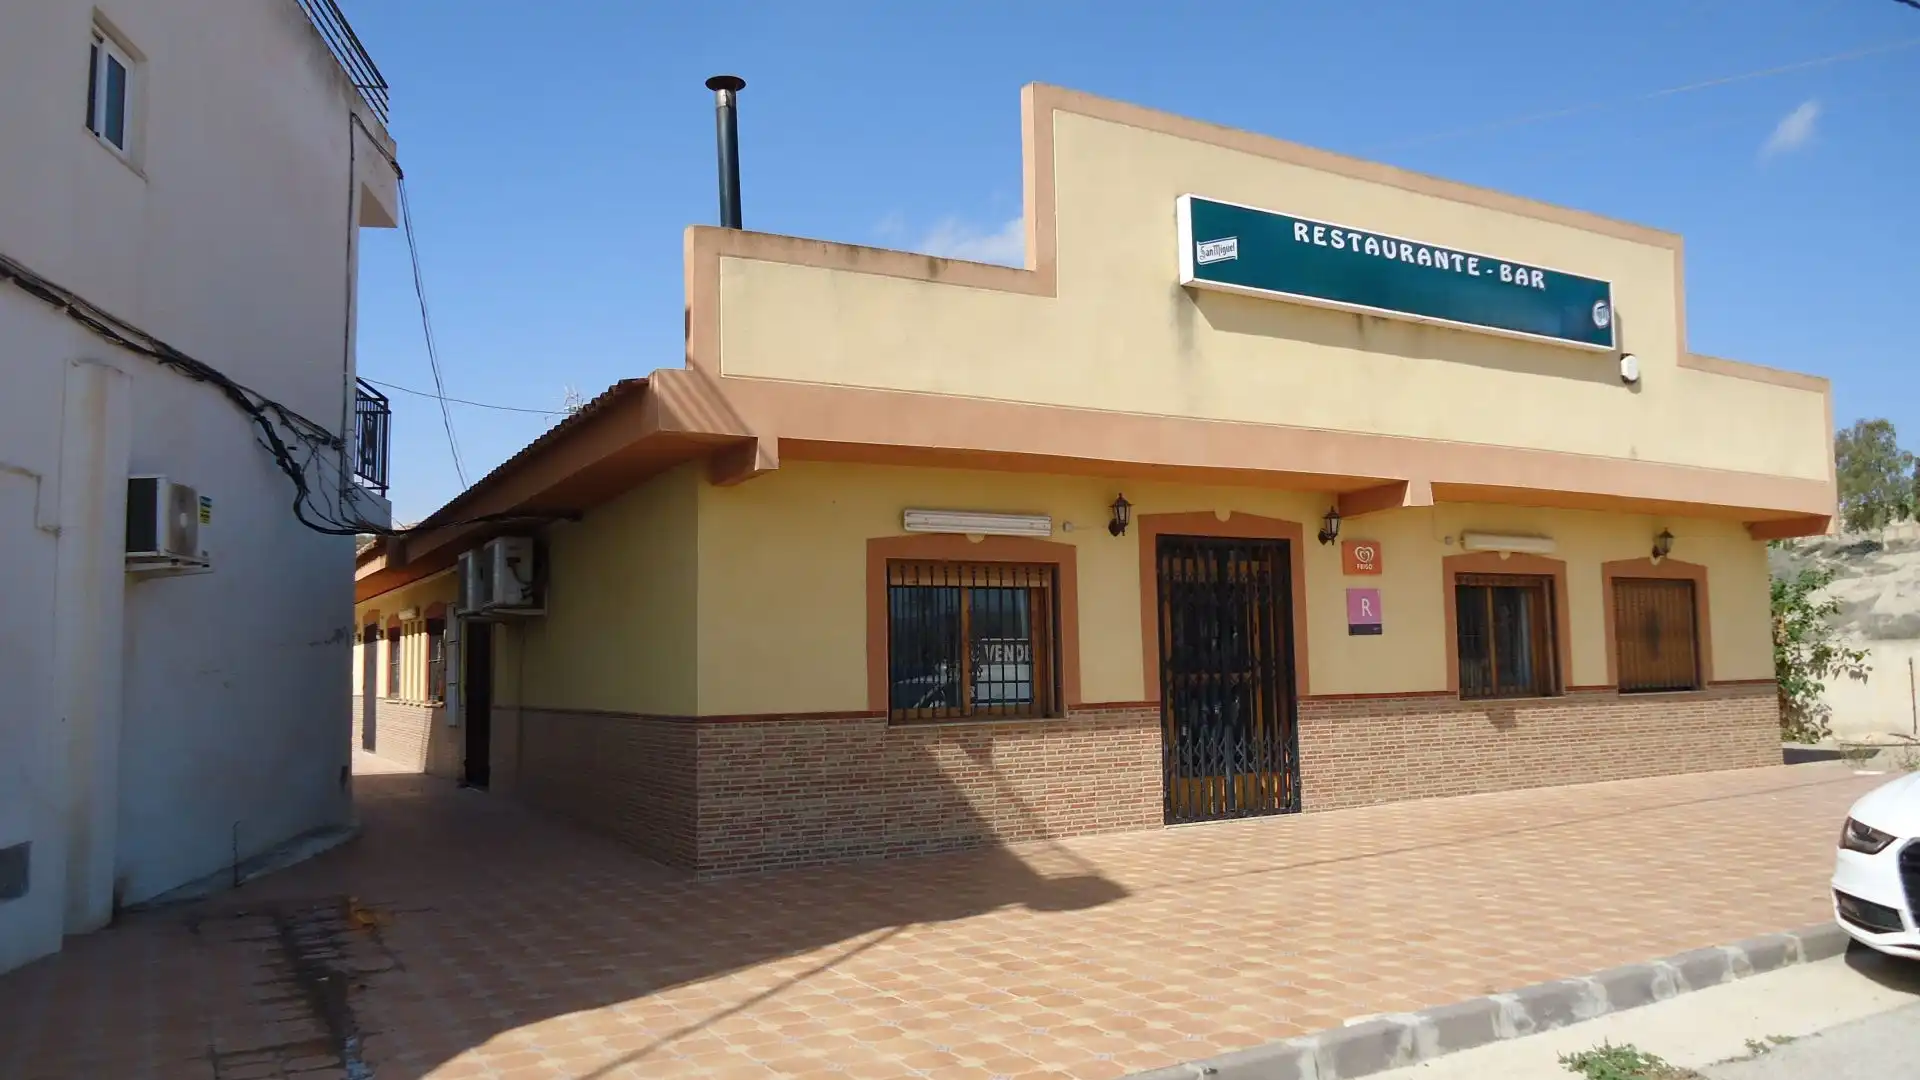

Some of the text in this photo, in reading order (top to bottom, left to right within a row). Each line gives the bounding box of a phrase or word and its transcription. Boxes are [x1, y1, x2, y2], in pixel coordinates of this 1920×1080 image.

[1293, 221, 1481, 277] RESTAURANTE
[1499, 263, 1546, 290] BAR
[1361, 598, 1373, 617] R
